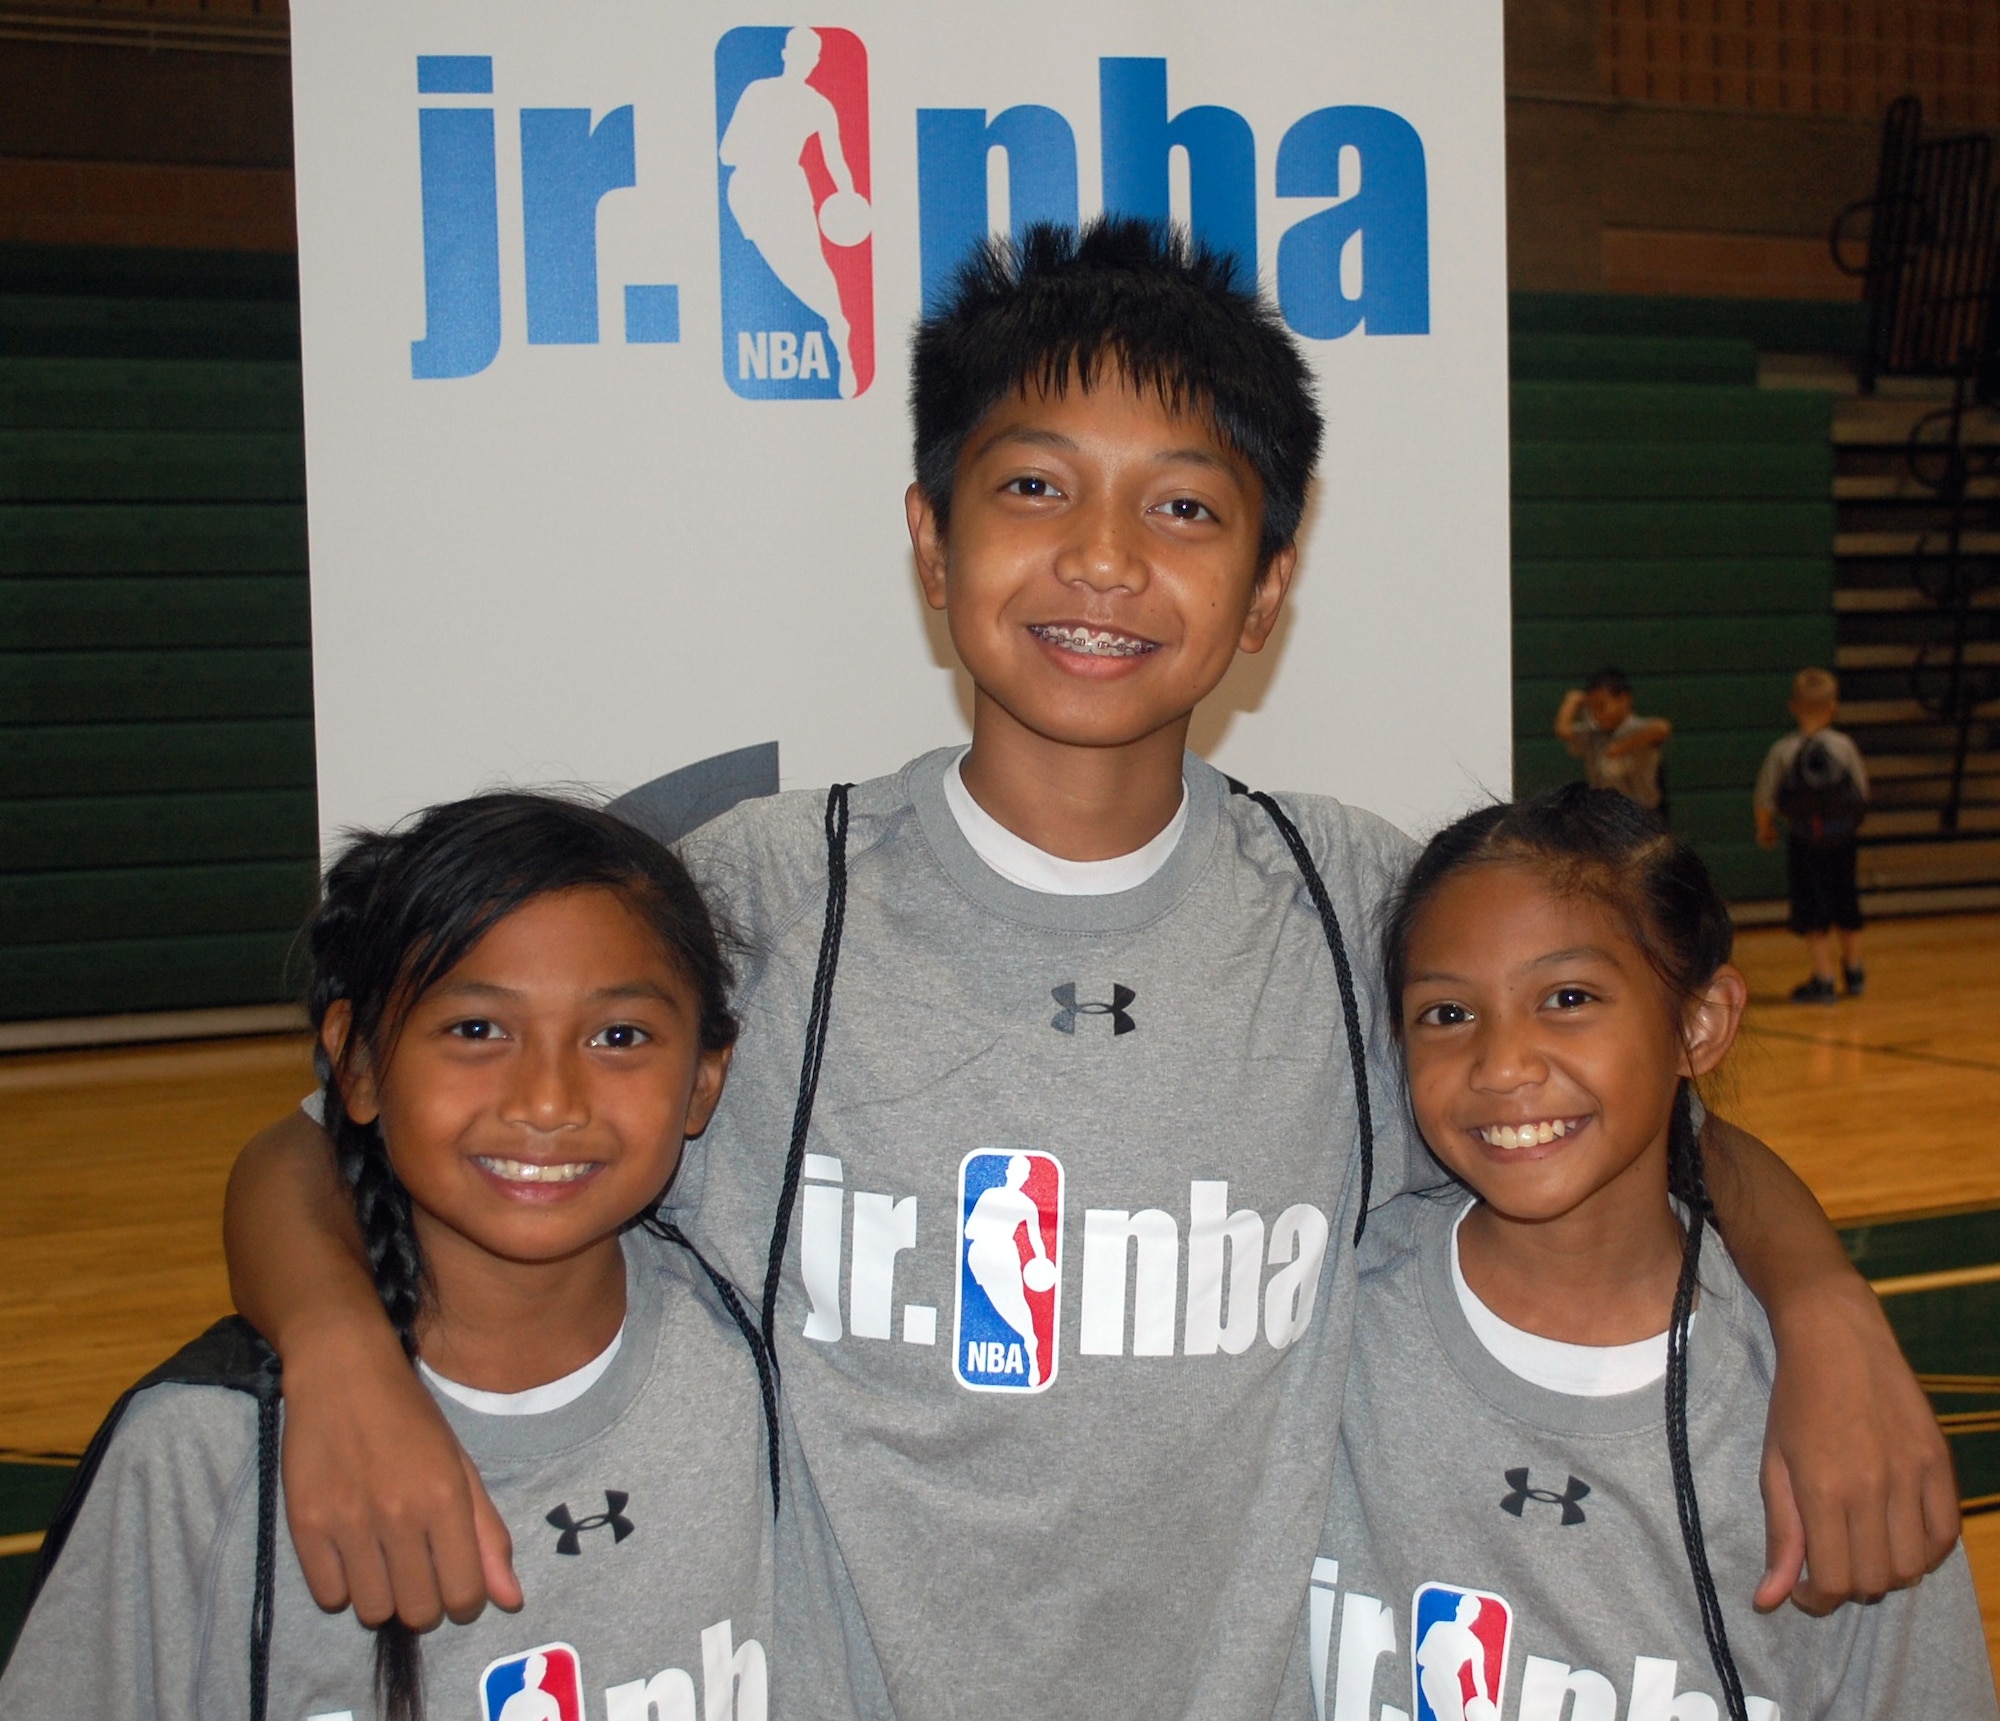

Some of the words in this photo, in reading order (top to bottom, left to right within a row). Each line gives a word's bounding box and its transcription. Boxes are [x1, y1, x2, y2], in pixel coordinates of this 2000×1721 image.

[411, 55, 679, 380] jr.
[738, 331, 830, 380] NBA
[801, 1153, 937, 1345] jr.
[1080, 1180, 1329, 1356] nba
[967, 1341, 1024, 1374] NBA
